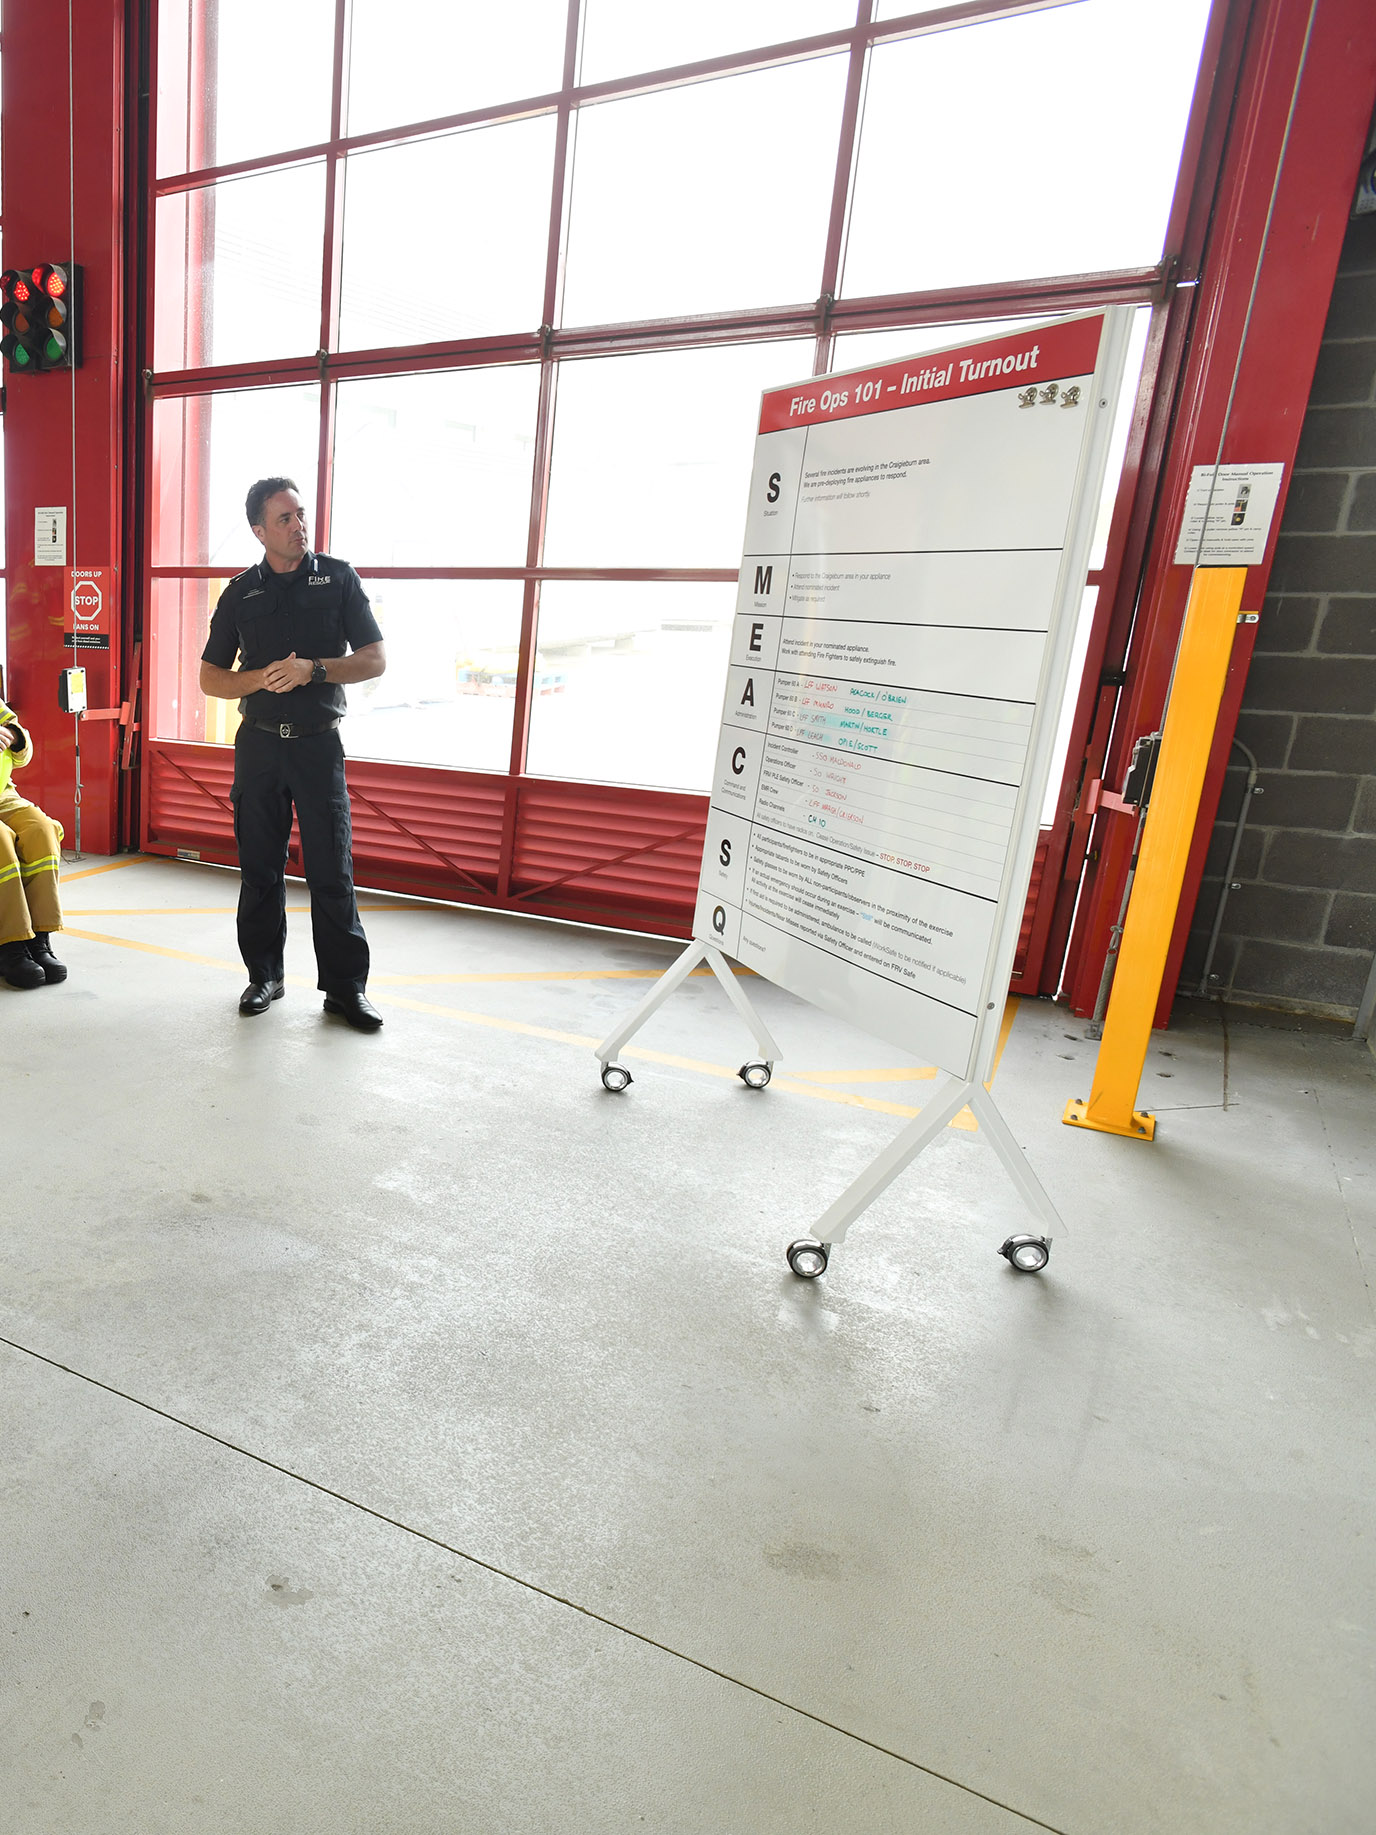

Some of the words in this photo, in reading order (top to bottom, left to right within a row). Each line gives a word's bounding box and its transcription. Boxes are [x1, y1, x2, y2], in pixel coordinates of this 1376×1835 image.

[789, 397, 815, 415] Fire
[820, 391, 848, 412] Ops
[855, 380, 881, 402] 101
[901, 364, 952, 393] Initial
[960, 346, 1038, 381] Turnout
[888, 460, 917, 468] Craigieburn
[766, 472, 780, 502] S
[817, 478, 846, 487] pre-deploying
[886, 471, 906, 479] respond.
[754, 566, 772, 594] M
[74, 596, 99, 605] STOP
[749, 623, 763, 651] E
[741, 678, 754, 706] A
[732, 746, 745, 774] C
[765, 756, 783, 766] Operations
[790, 778, 803, 786] Officer
[719, 839, 731, 866] S
[819, 857, 843, 869] appropriate
[817, 868, 830, 878] Safety
[830, 873, 847, 884] Officers
[913, 863, 930, 872] STOP
[712, 905, 725, 935] Q
[791, 885, 804, 894] should
[816, 895, 830, 905] during
[837, 904, 855, 914] exercise
[891, 925, 931, 944] communicated.
[813, 881, 870, 906] non-participants/observers
[886, 909, 910, 922] proximity
[918, 919, 927, 928] the
[928, 924, 953, 936] exercise
[814, 905, 839, 919] immediately
[821, 921, 844, 934] ambulance
[857, 936, 871, 946] called
[799, 924, 816, 936] reported
[824, 934, 837, 946] Safety
[838, 941, 853, 951] Officer
[863, 953, 882, 964] entered
[890, 963, 902, 972] FRV
[902, 968, 915, 978] Safe
